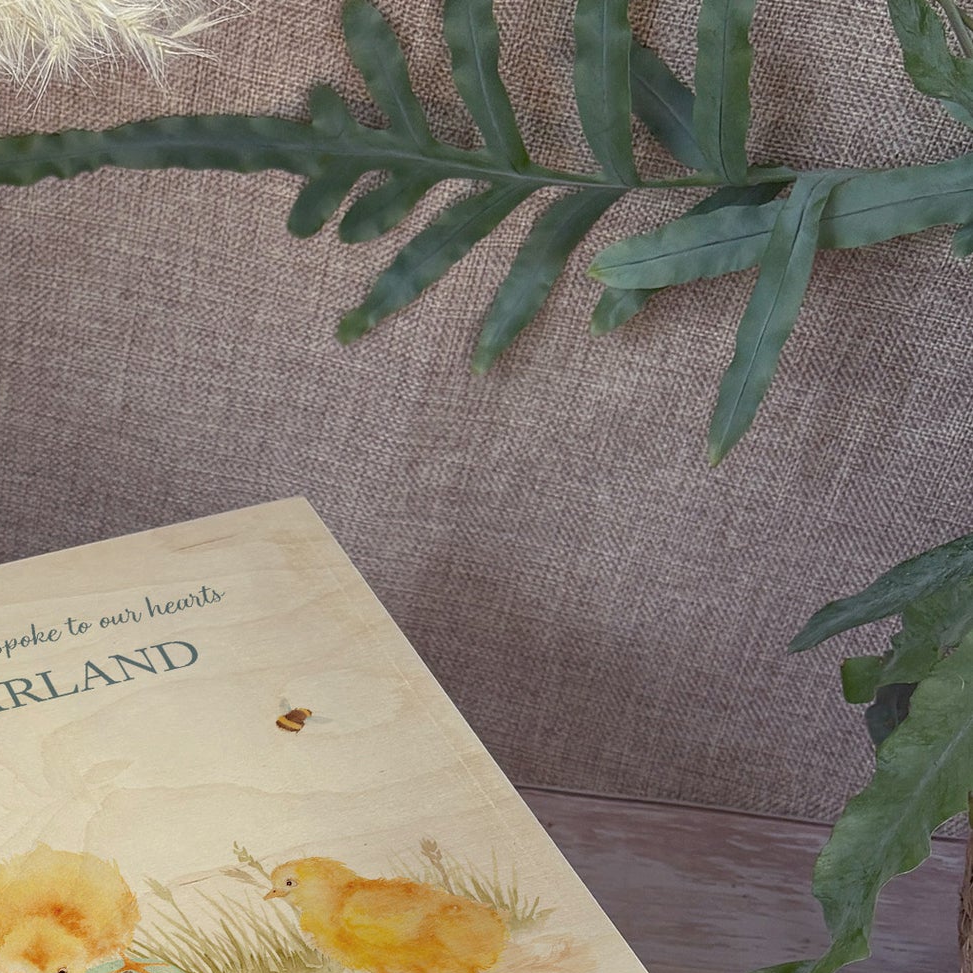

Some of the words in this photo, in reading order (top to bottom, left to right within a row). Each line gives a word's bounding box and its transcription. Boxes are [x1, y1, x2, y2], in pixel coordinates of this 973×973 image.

[65, 616, 93, 635] to
[99, 608, 142, 628] our
[145, 585, 226, 618] hearts
